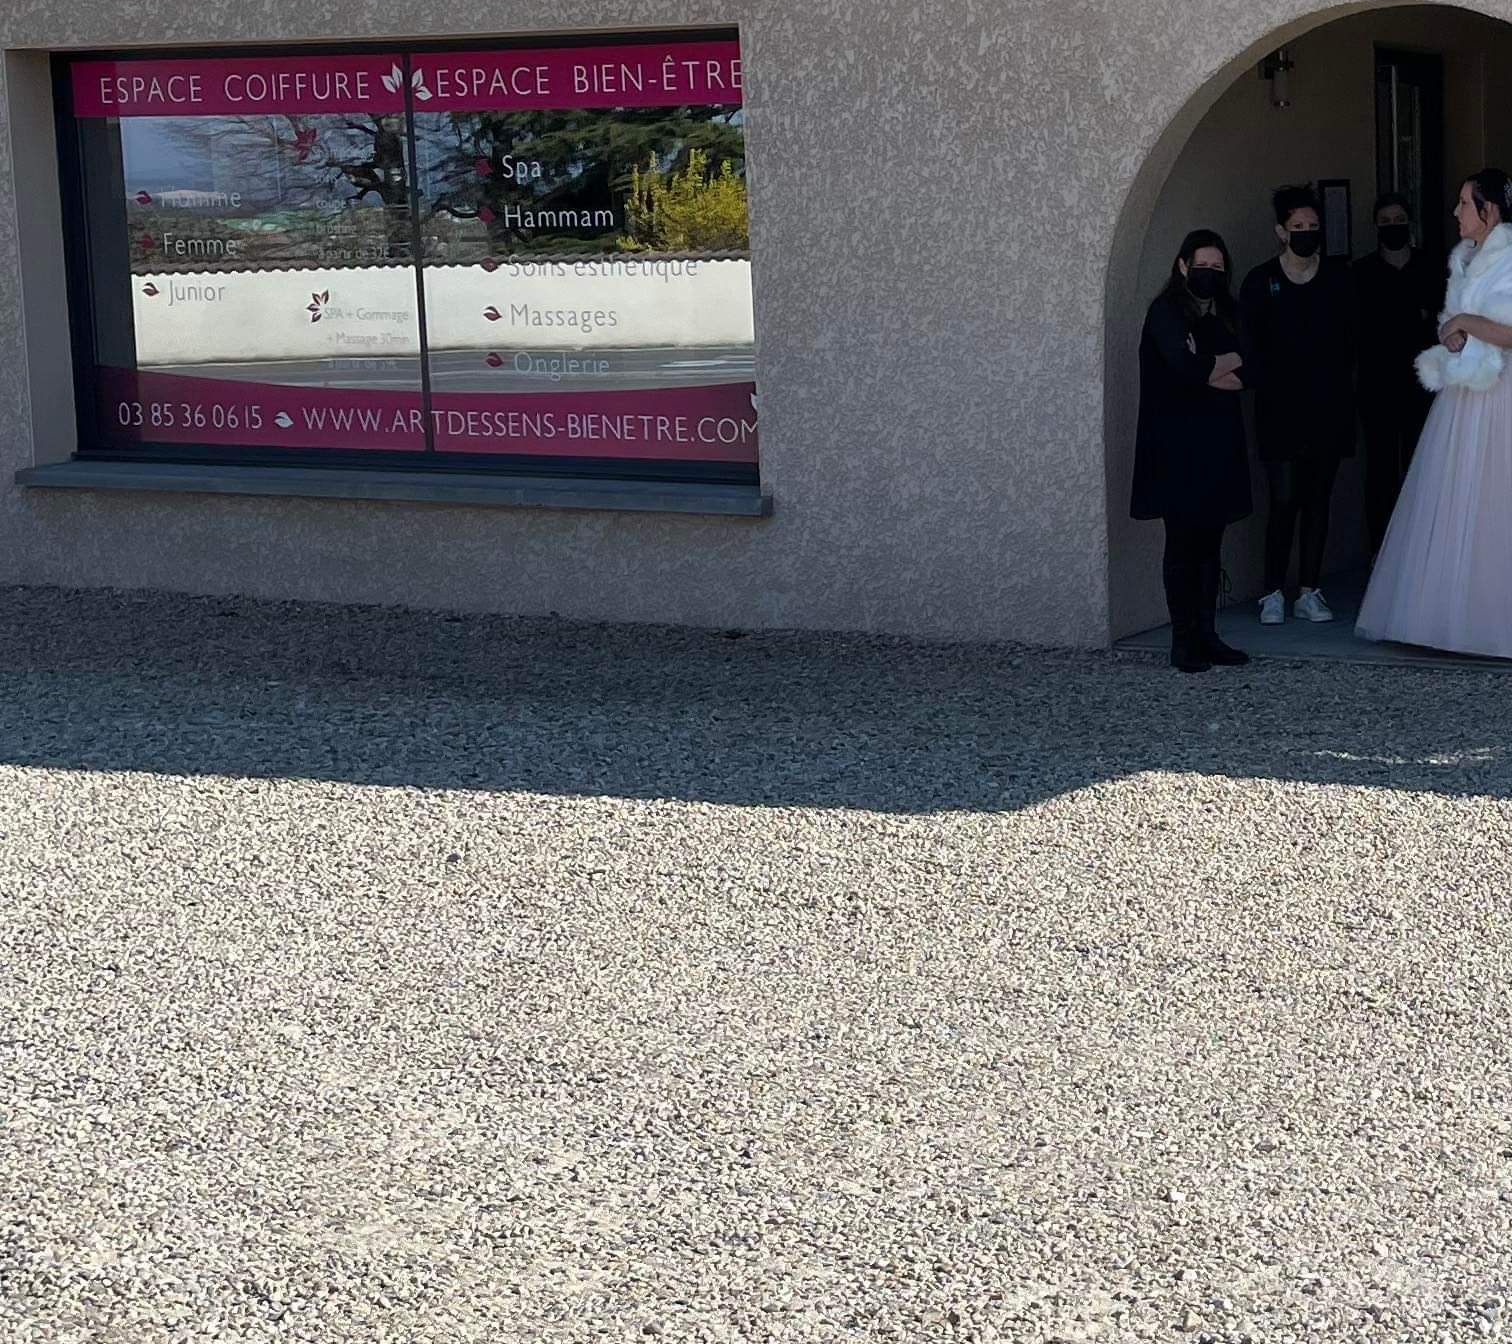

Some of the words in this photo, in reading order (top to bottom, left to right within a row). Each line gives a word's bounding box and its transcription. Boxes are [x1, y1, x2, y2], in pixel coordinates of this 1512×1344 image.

[100, 75, 203, 104] ESPACE
[224, 71, 371, 101] COIFFURE
[435, 66, 551, 98] ESPACE
[573, 54, 743, 94] BIEN-ÊTRE
[502, 155, 542, 185] Spa
[504, 205, 615, 228] Hammam
[163, 232, 238, 256] Femme
[509, 254, 567, 278] Soins
[168, 280, 225, 306] Junior
[510, 304, 618, 333] Massages
[513, 352, 611, 381] Onglerie
[118, 401, 144, 426] 03
[151, 403, 175, 427] 85
[182, 404, 206, 428] 36
[212, 404, 239, 429] 06
[245, 405, 263, 429] 15
